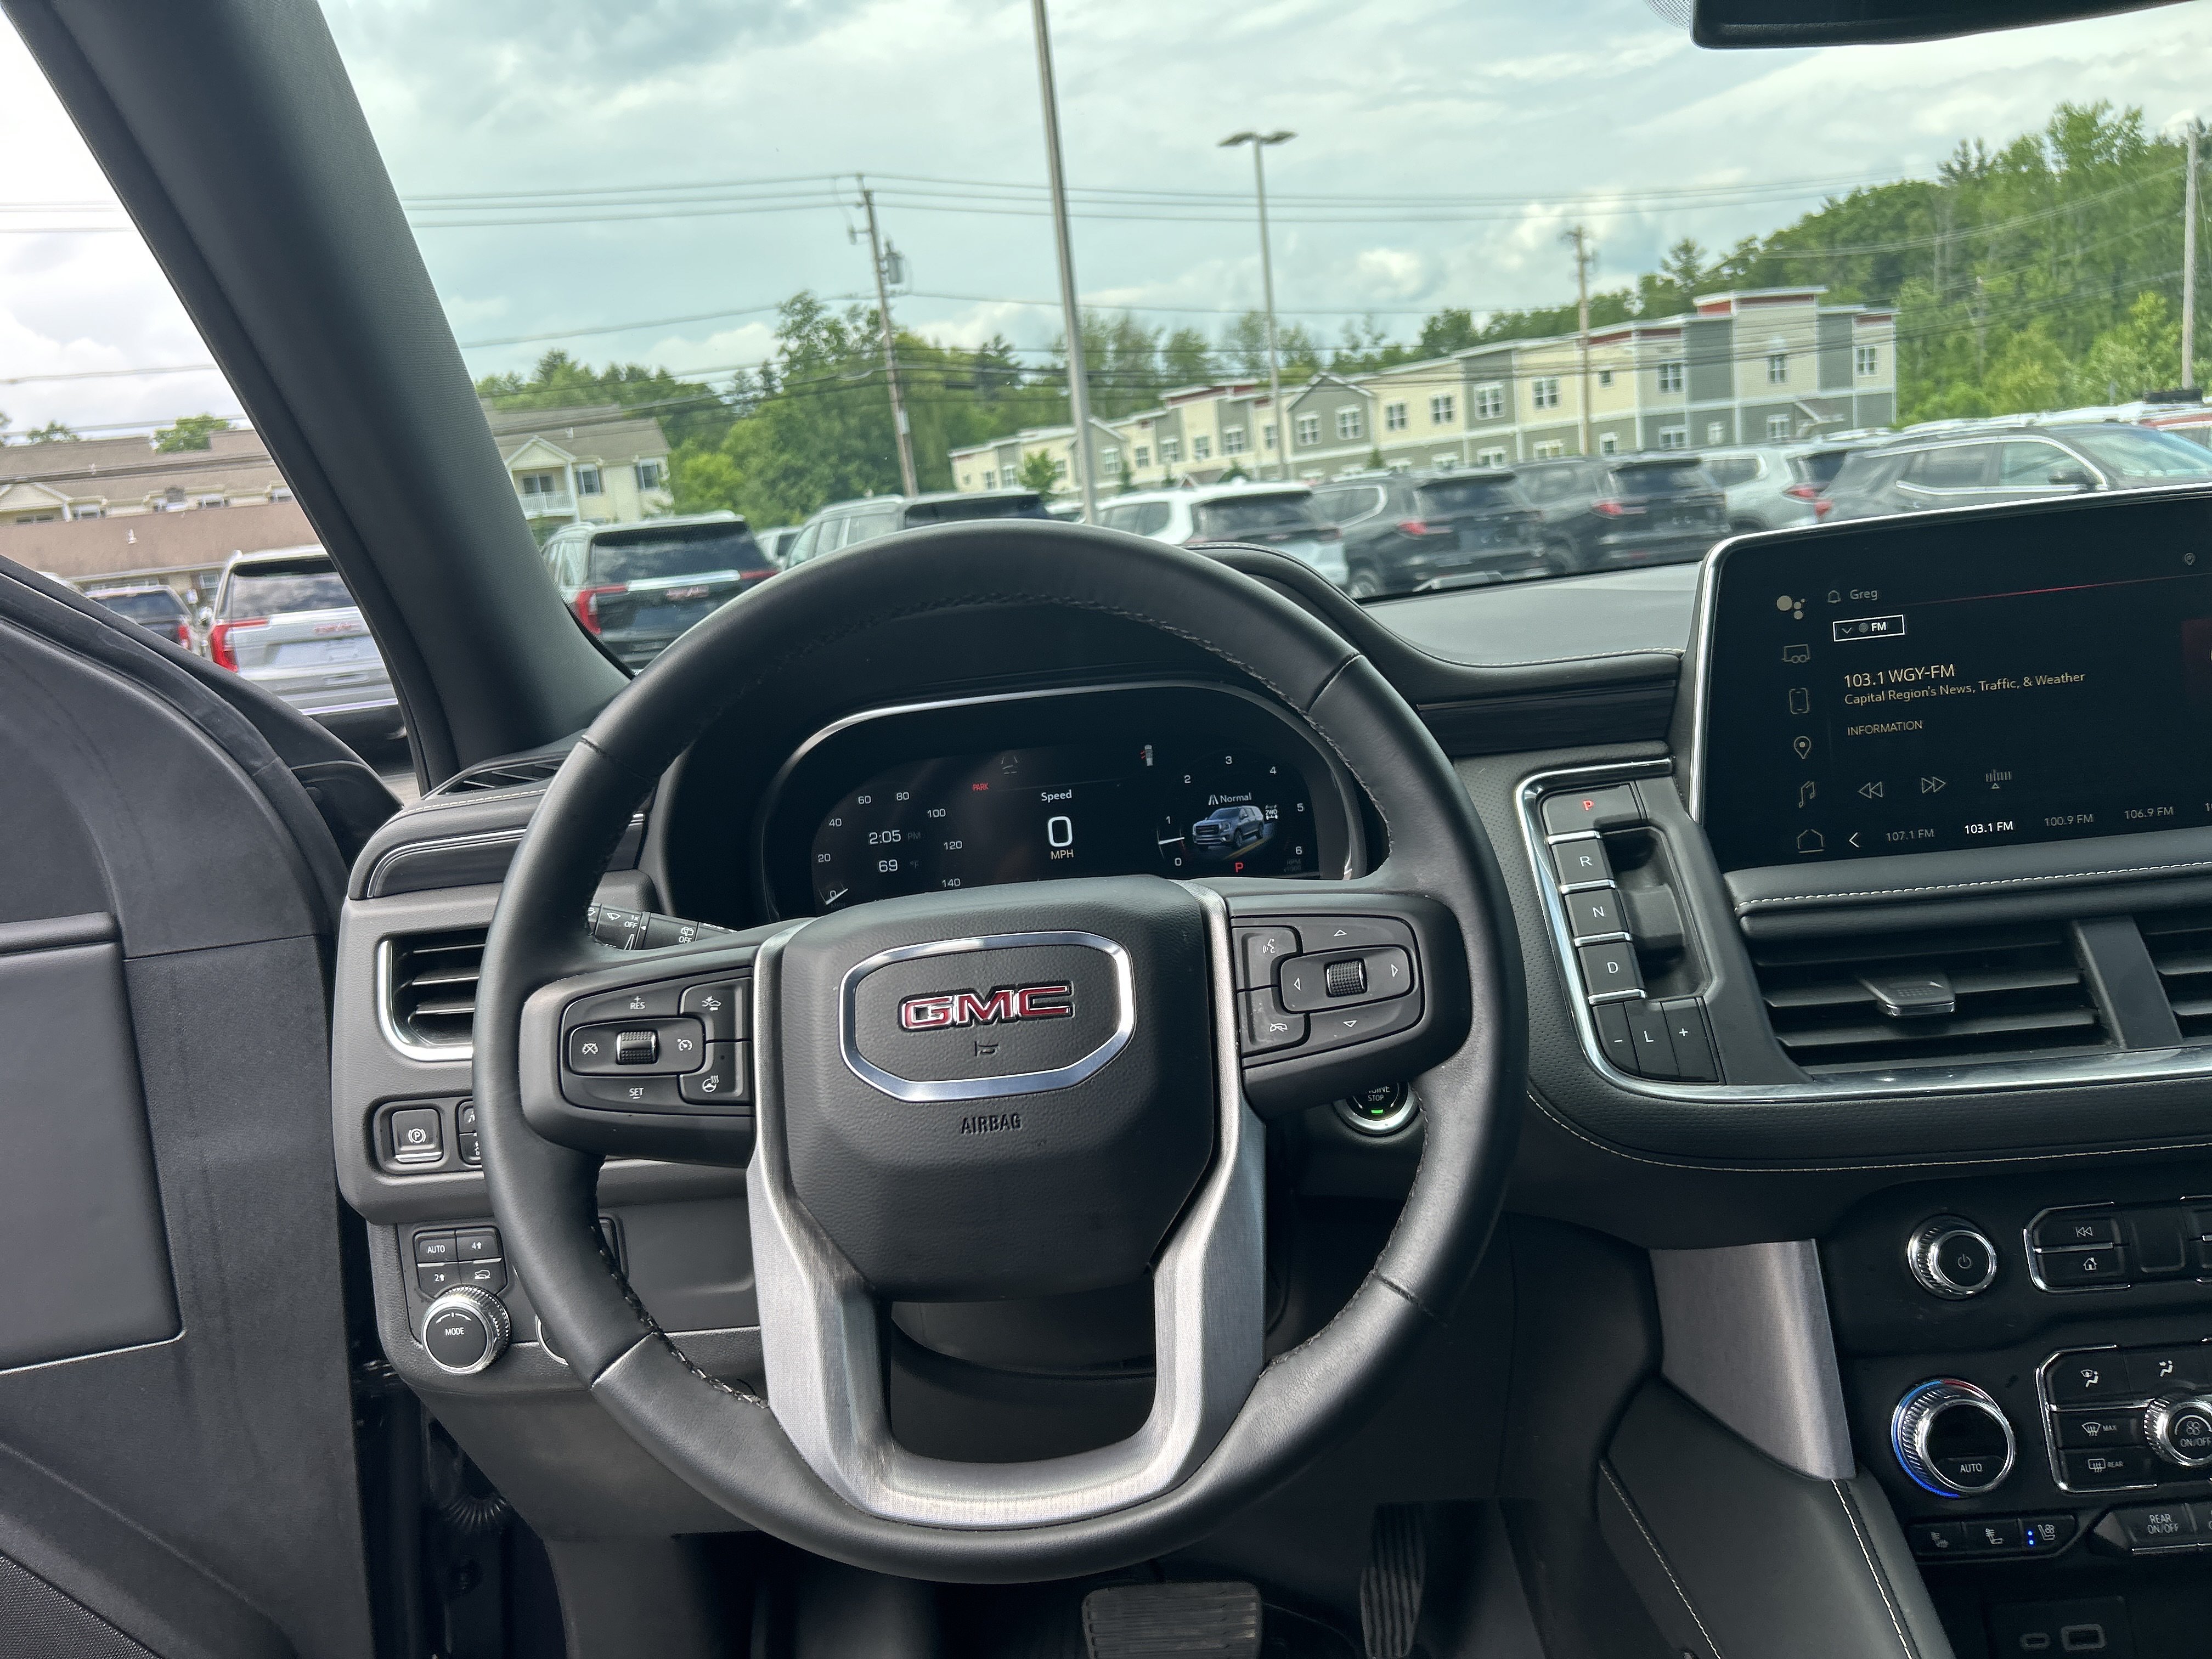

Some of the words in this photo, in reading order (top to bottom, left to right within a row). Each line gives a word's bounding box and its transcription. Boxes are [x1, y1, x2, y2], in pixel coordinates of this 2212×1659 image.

[1849, 589, 1878, 601] Greg
[1871, 622, 1886, 631] FM
[1844, 672, 1884, 687] 103.1
[1888, 664, 1955, 682] WGY-FM
[1844, 691, 1885, 706] Capital
[1888, 686, 1937, 702] Region's
[1940, 685, 1976, 695] News,
[1978, 678, 2020, 691] Traffic,
[2023, 676, 2033, 687] &
[2035, 672, 2085, 685] Weather
[1847, 720, 1922, 736] INFORMATION
[1224, 756, 1233, 765] 3
[1269, 766, 1277, 775] 4
[1184, 775, 1191, 783] 2
[972, 782, 989, 791] PARK
[857, 795, 871, 804] 60
[896, 792, 910, 801] 80
[1041, 789, 1072, 803] Speed
[1220, 792, 1252, 804] Normal
[1297, 803, 1304, 812] 5
[1583, 800, 1594, 811] P
[927, 808, 946, 818] 100
[2124, 808, 2154, 819] 106.9
[2157, 806, 2174, 816] FM
[828, 818, 843, 827] 40
[1166, 816, 1171, 825] 1
[2044, 815, 2073, 827] 100.9
[2077, 814, 2094, 824] FM
[1048, 816, 1073, 847] 0
[1965, 823, 1993, 834] 103.1
[1996, 821, 2013, 832] FM
[868, 830, 901, 845] 2:05
[907, 831, 921, 840] PM
[1886, 830, 1915, 842] 107.1
[1918, 828, 1935, 839] FM
[944, 840, 963, 850] 120
[1051, 849, 1074, 860] MPH
[1295, 846, 1302, 855] 6
[817, 854, 831, 863] 20
[1175, 857, 1182, 866] 0
[1579, 855, 1593, 867] R
[878, 859, 898, 873] 69
[1234, 862, 1244, 872] P
[942, 878, 961, 888] 140
[830, 890, 837, 899] 0
[1592, 906, 1605, 918] N
[1606, 961, 1620, 974] D
[629, 1002, 646, 1010] RES
[901, 983, 1073, 1030] GMC
[1644, 1030, 1654, 1043] L
[629, 1087, 644, 1097] SET
[961, 1113, 1022, 1134] AIRBAG
[427, 1245, 445, 1254] AUTO
[445, 1327, 465, 1336] MODE
[1960, 1463, 1982, 1473] AUTO
[2149, 1513, 2172, 1524] REAR
[2147, 1523, 2179, 1534] ON/OFF
